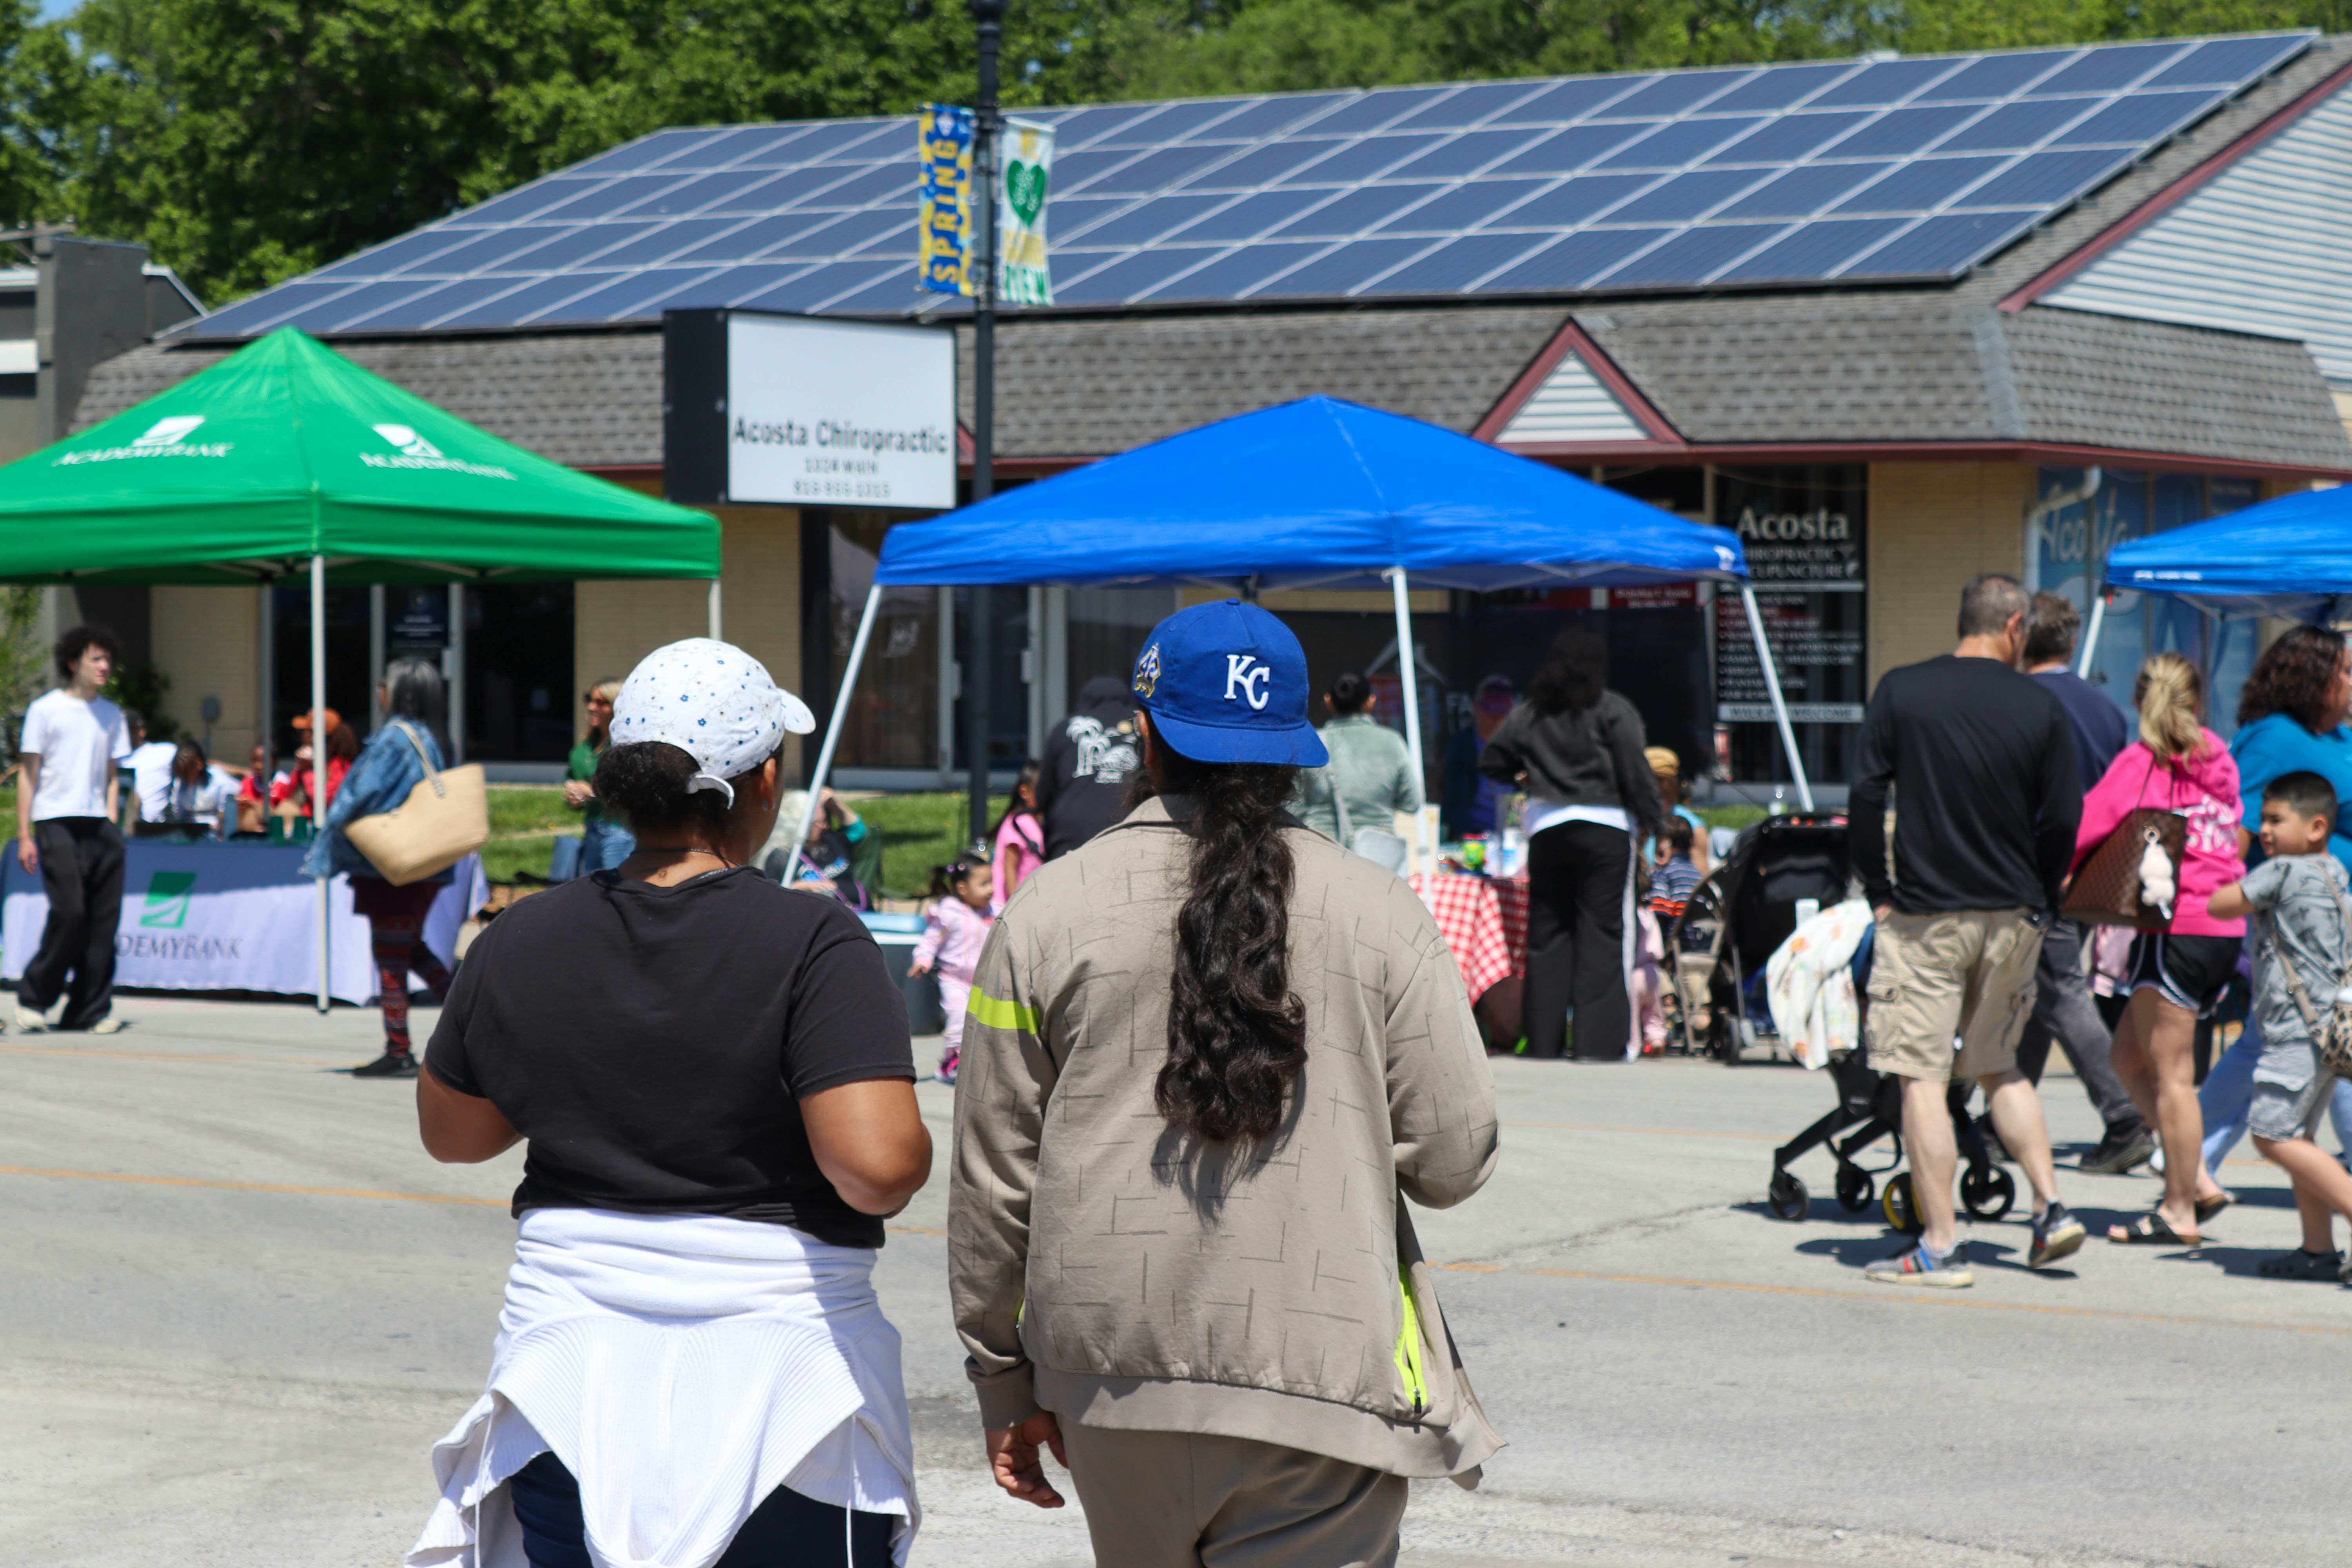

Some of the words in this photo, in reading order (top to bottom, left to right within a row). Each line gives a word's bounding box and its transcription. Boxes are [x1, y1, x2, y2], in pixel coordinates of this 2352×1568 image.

[931, 140, 959, 284] SPRING
[733, 416, 808, 447] Acosta
[816, 419, 949, 455] Chiropractic
[1735, 506, 1850, 540] Acosta
[1745, 546, 1838, 562] HIROPRACTIC
[1749, 562, 1844, 579] CUPUNCTURE
[1224, 654, 1270, 710] KC
[116, 932, 243, 960] DEMYBANK
